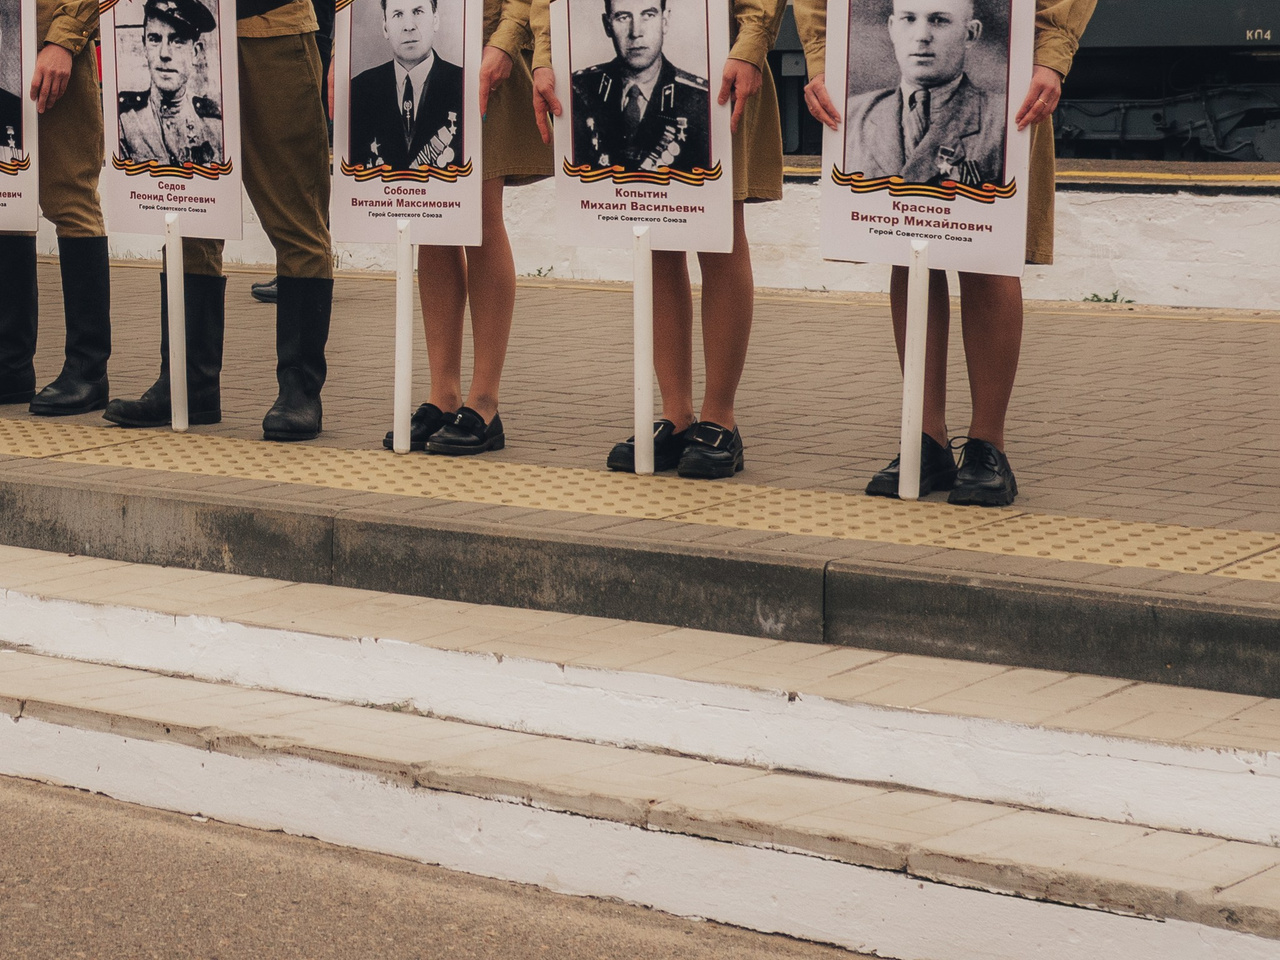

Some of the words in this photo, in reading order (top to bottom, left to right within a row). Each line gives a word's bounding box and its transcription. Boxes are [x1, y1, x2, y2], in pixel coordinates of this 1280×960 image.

[158, 181, 185, 191] Седов
[384, 186, 426, 195] Соболев
[130, 191, 164, 202] Леонид
[167, 194, 215, 204] Сергеевич
[616, 188, 667, 198] Копытин
[352, 198, 392, 207] Виталий
[397, 199, 460, 208] Максимович
[581, 200, 626, 210] Михаил
[631, 202, 704, 213] Васильевич
[892, 201, 951, 214] Краснов
[851, 212, 899, 226] Виктор
[904, 216, 992, 232] Михайлович
[869, 228, 893, 236] Герой
[896, 230, 942, 240] Советского
[945, 234, 972, 242] Союза
